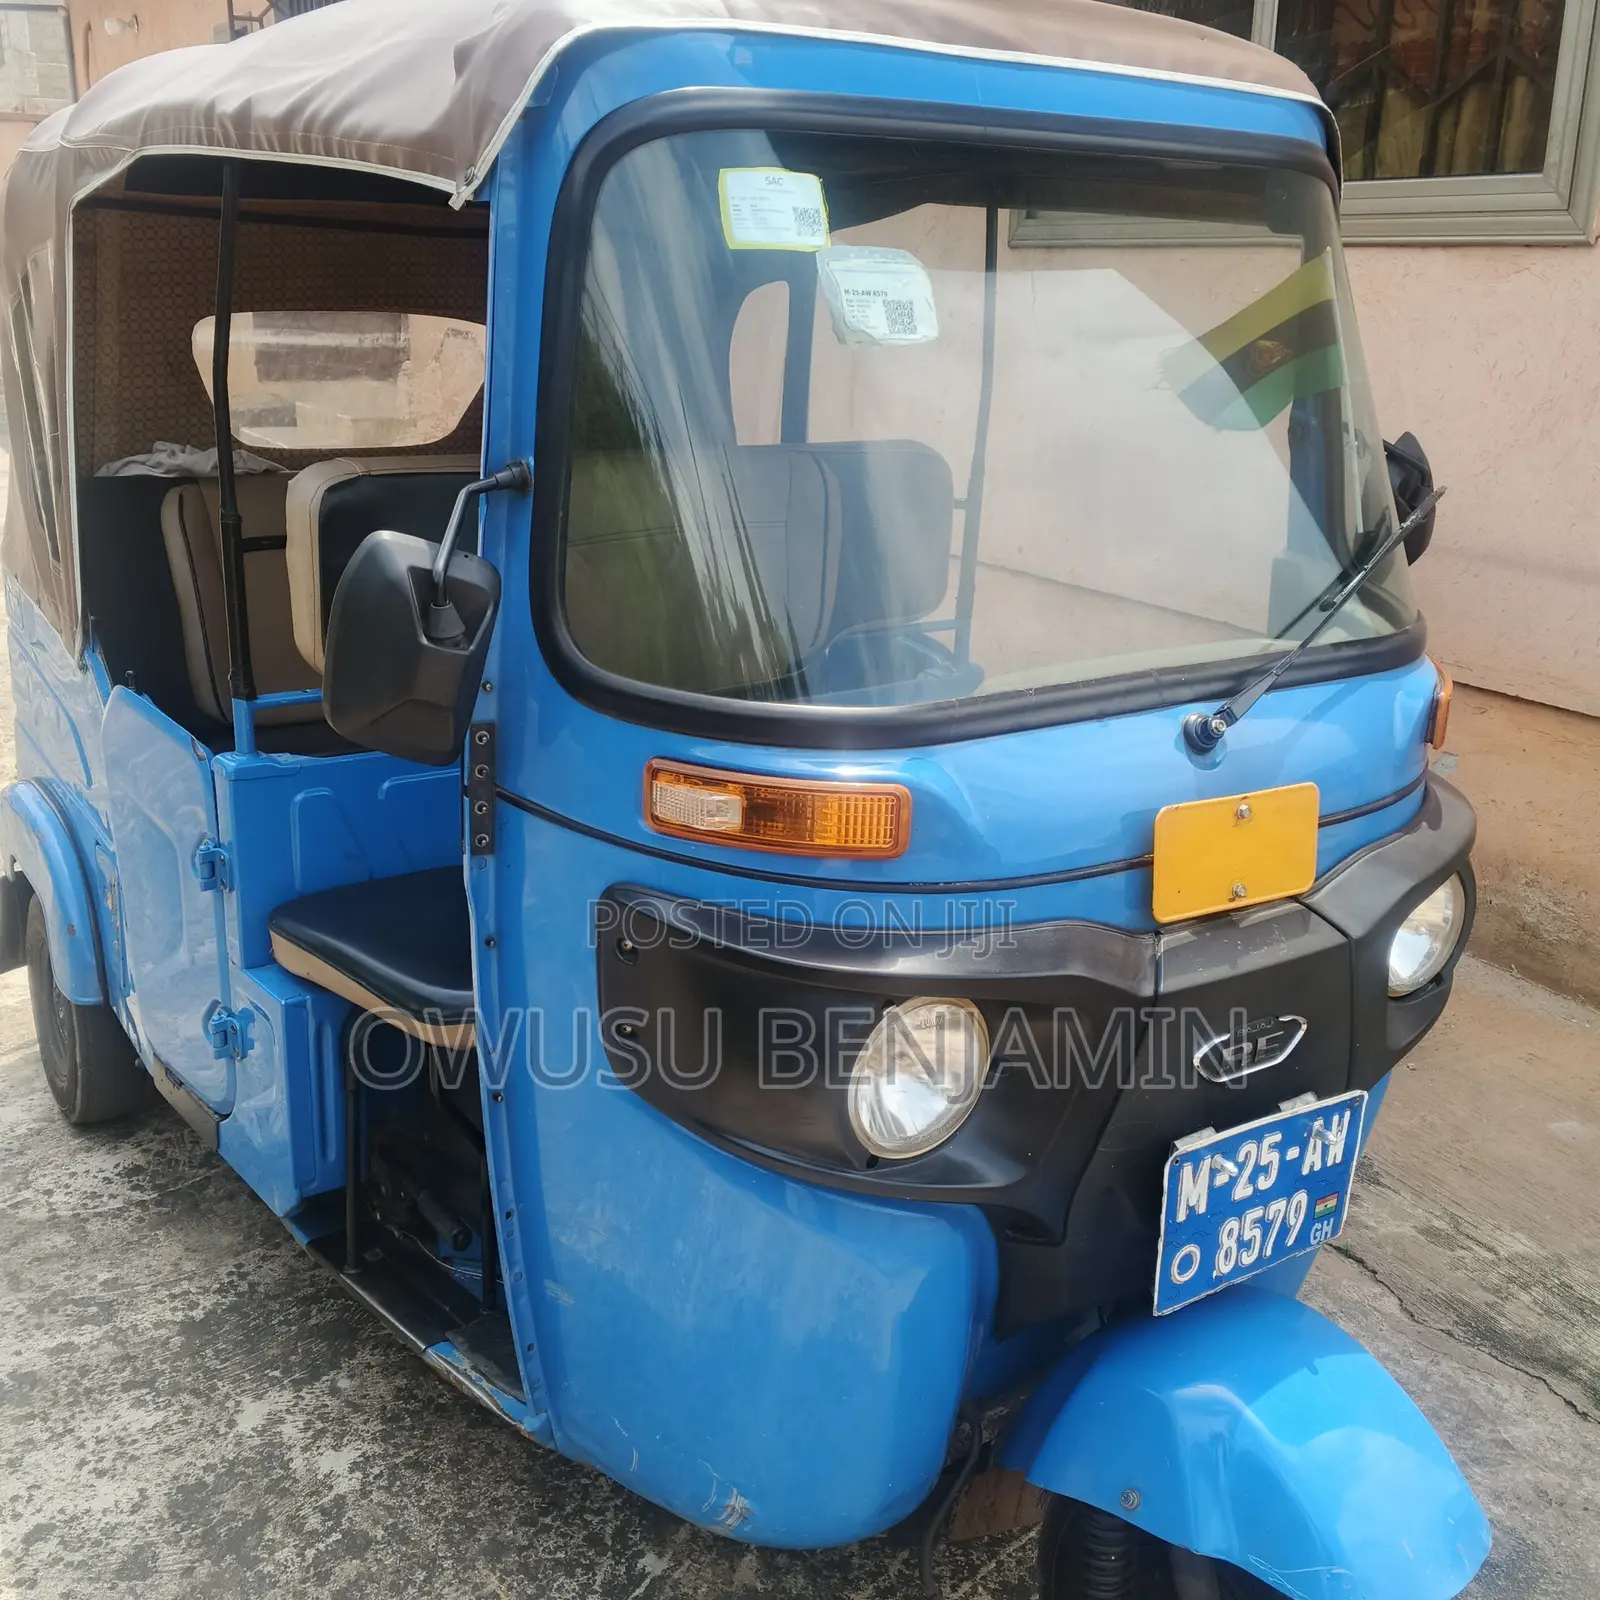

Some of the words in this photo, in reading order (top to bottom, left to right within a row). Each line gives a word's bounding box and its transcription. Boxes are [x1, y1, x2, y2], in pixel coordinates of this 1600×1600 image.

[764, 176, 784, 186] SAC
[1236, 1019, 1274, 1037] BAJAJ
[1220, 1031, 1284, 1072] RE
[1215, 1189, 1307, 1276] 8579
[1310, 1218, 1333, 1245] GH
